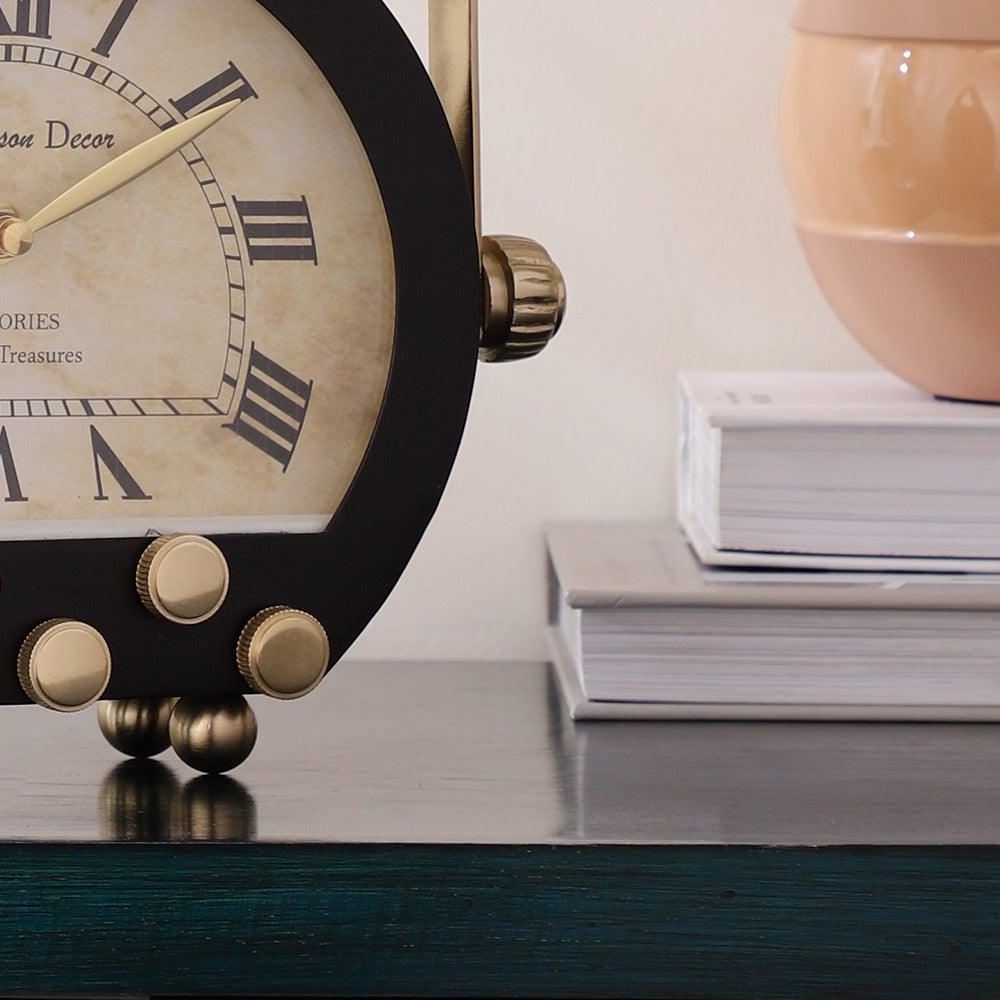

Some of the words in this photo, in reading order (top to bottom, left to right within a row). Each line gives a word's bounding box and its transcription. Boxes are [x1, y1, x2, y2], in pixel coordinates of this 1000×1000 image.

[44, 119, 116, 150] Decor
[231, 195, 319, 267] III
[89, 423, 153, 500] V
